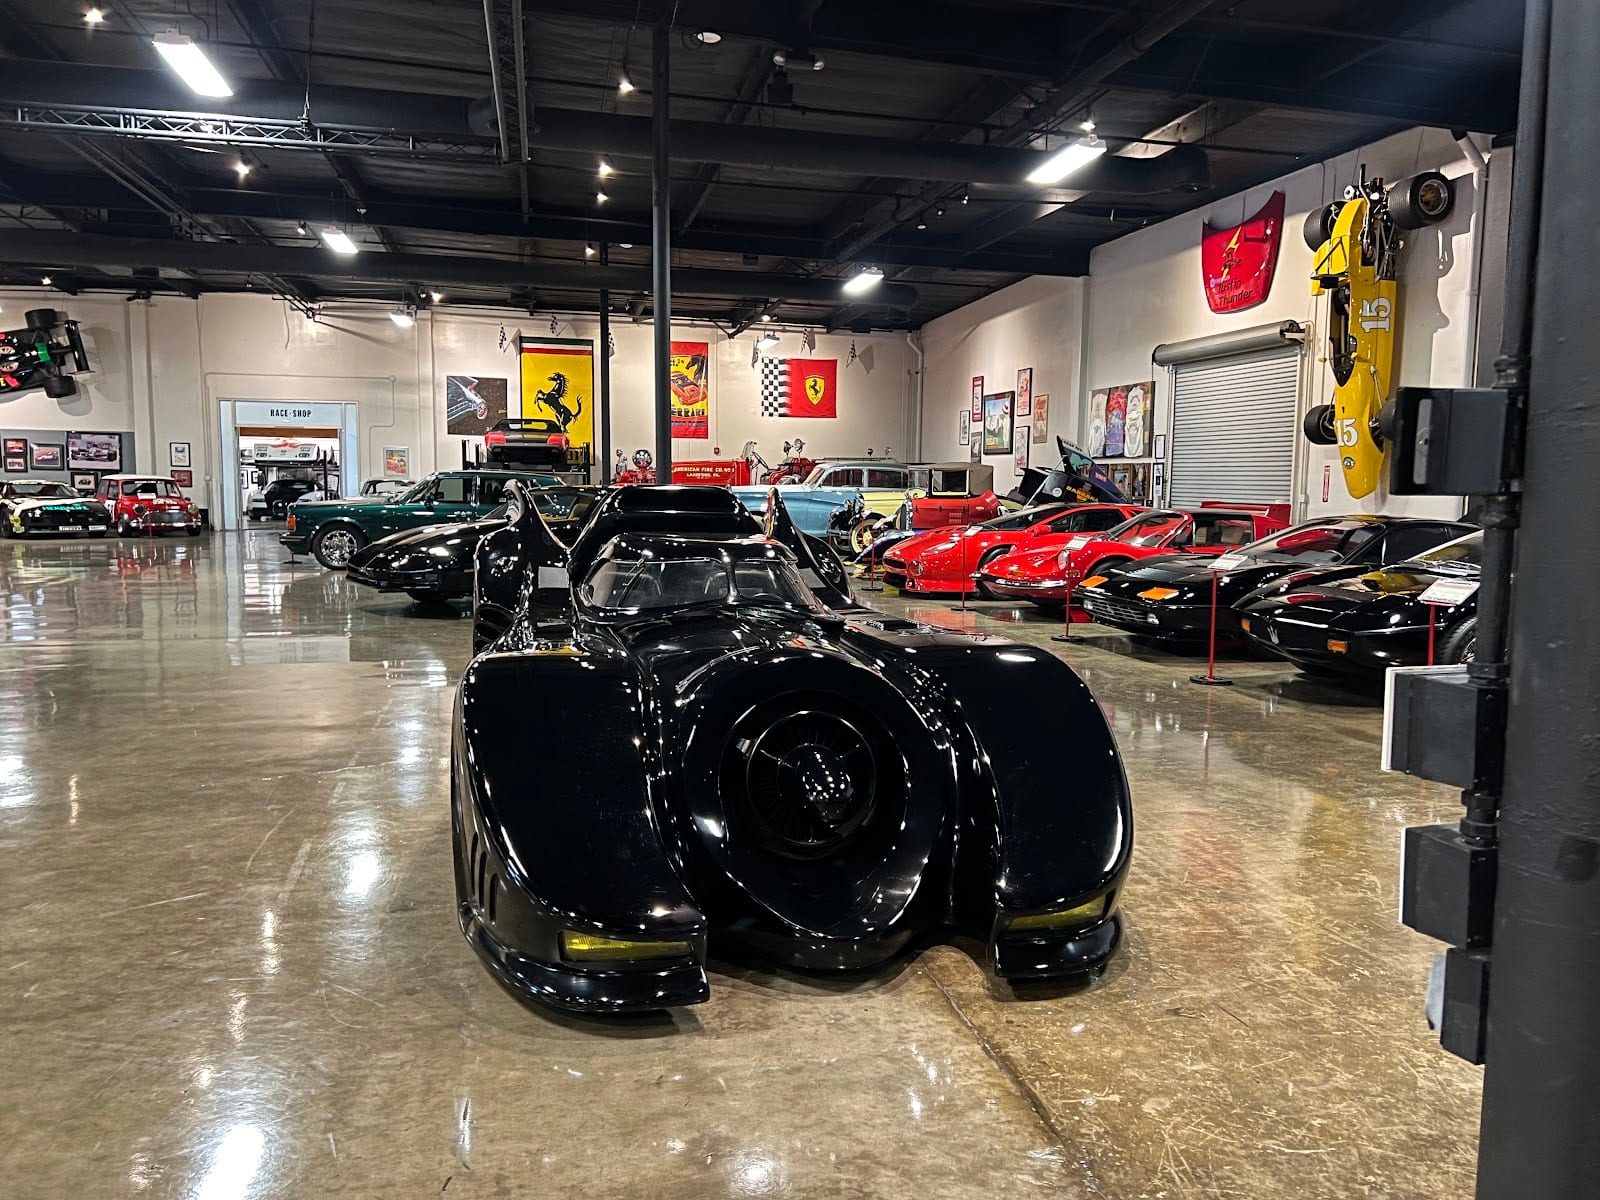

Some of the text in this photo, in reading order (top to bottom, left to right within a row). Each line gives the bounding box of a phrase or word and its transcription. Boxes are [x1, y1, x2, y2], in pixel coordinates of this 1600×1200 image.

[1219, 289, 1254, 306] Thunder
[1361, 297, 1391, 333] 15
[1335, 418, 1359, 447] 15
